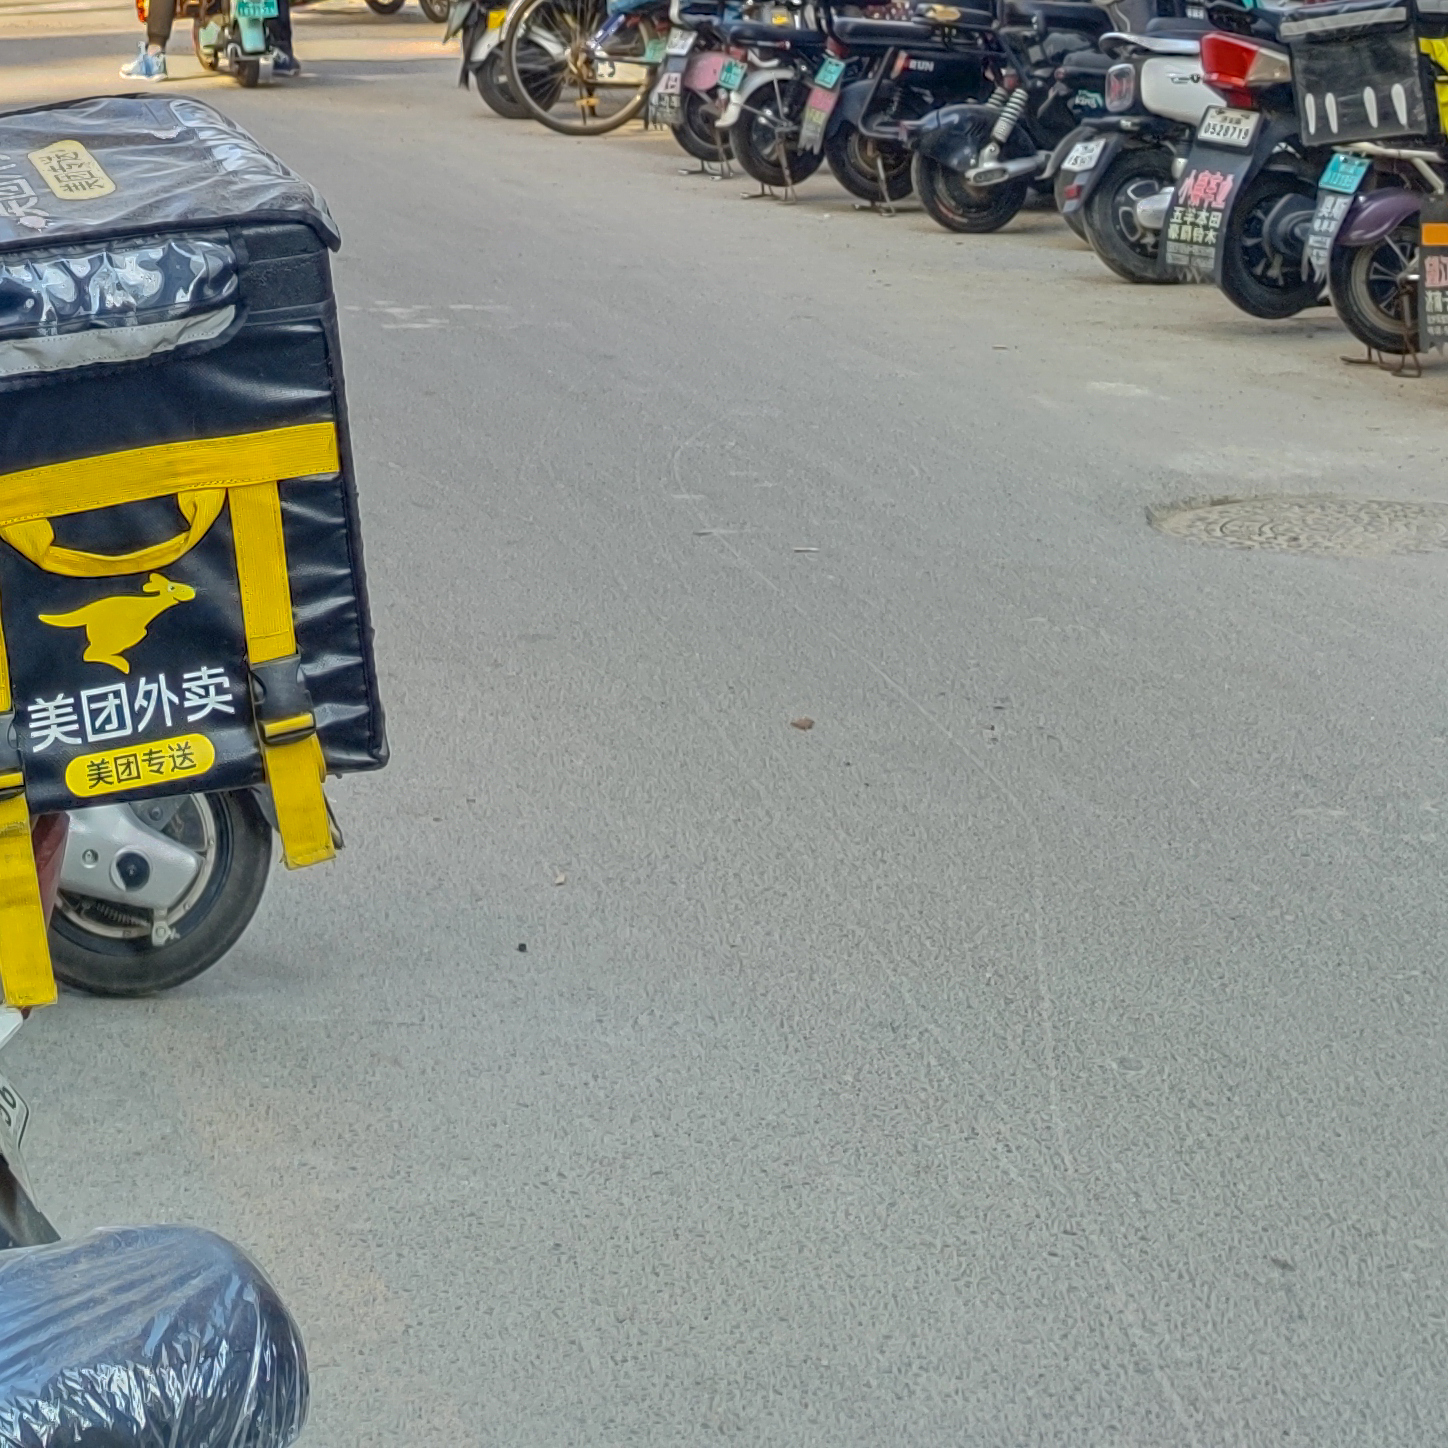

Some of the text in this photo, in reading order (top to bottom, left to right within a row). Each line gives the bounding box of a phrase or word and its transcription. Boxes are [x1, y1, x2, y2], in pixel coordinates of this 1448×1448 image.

[27, 666, 235, 753] 美团外卖
[86, 741, 197, 789] 美团专送
